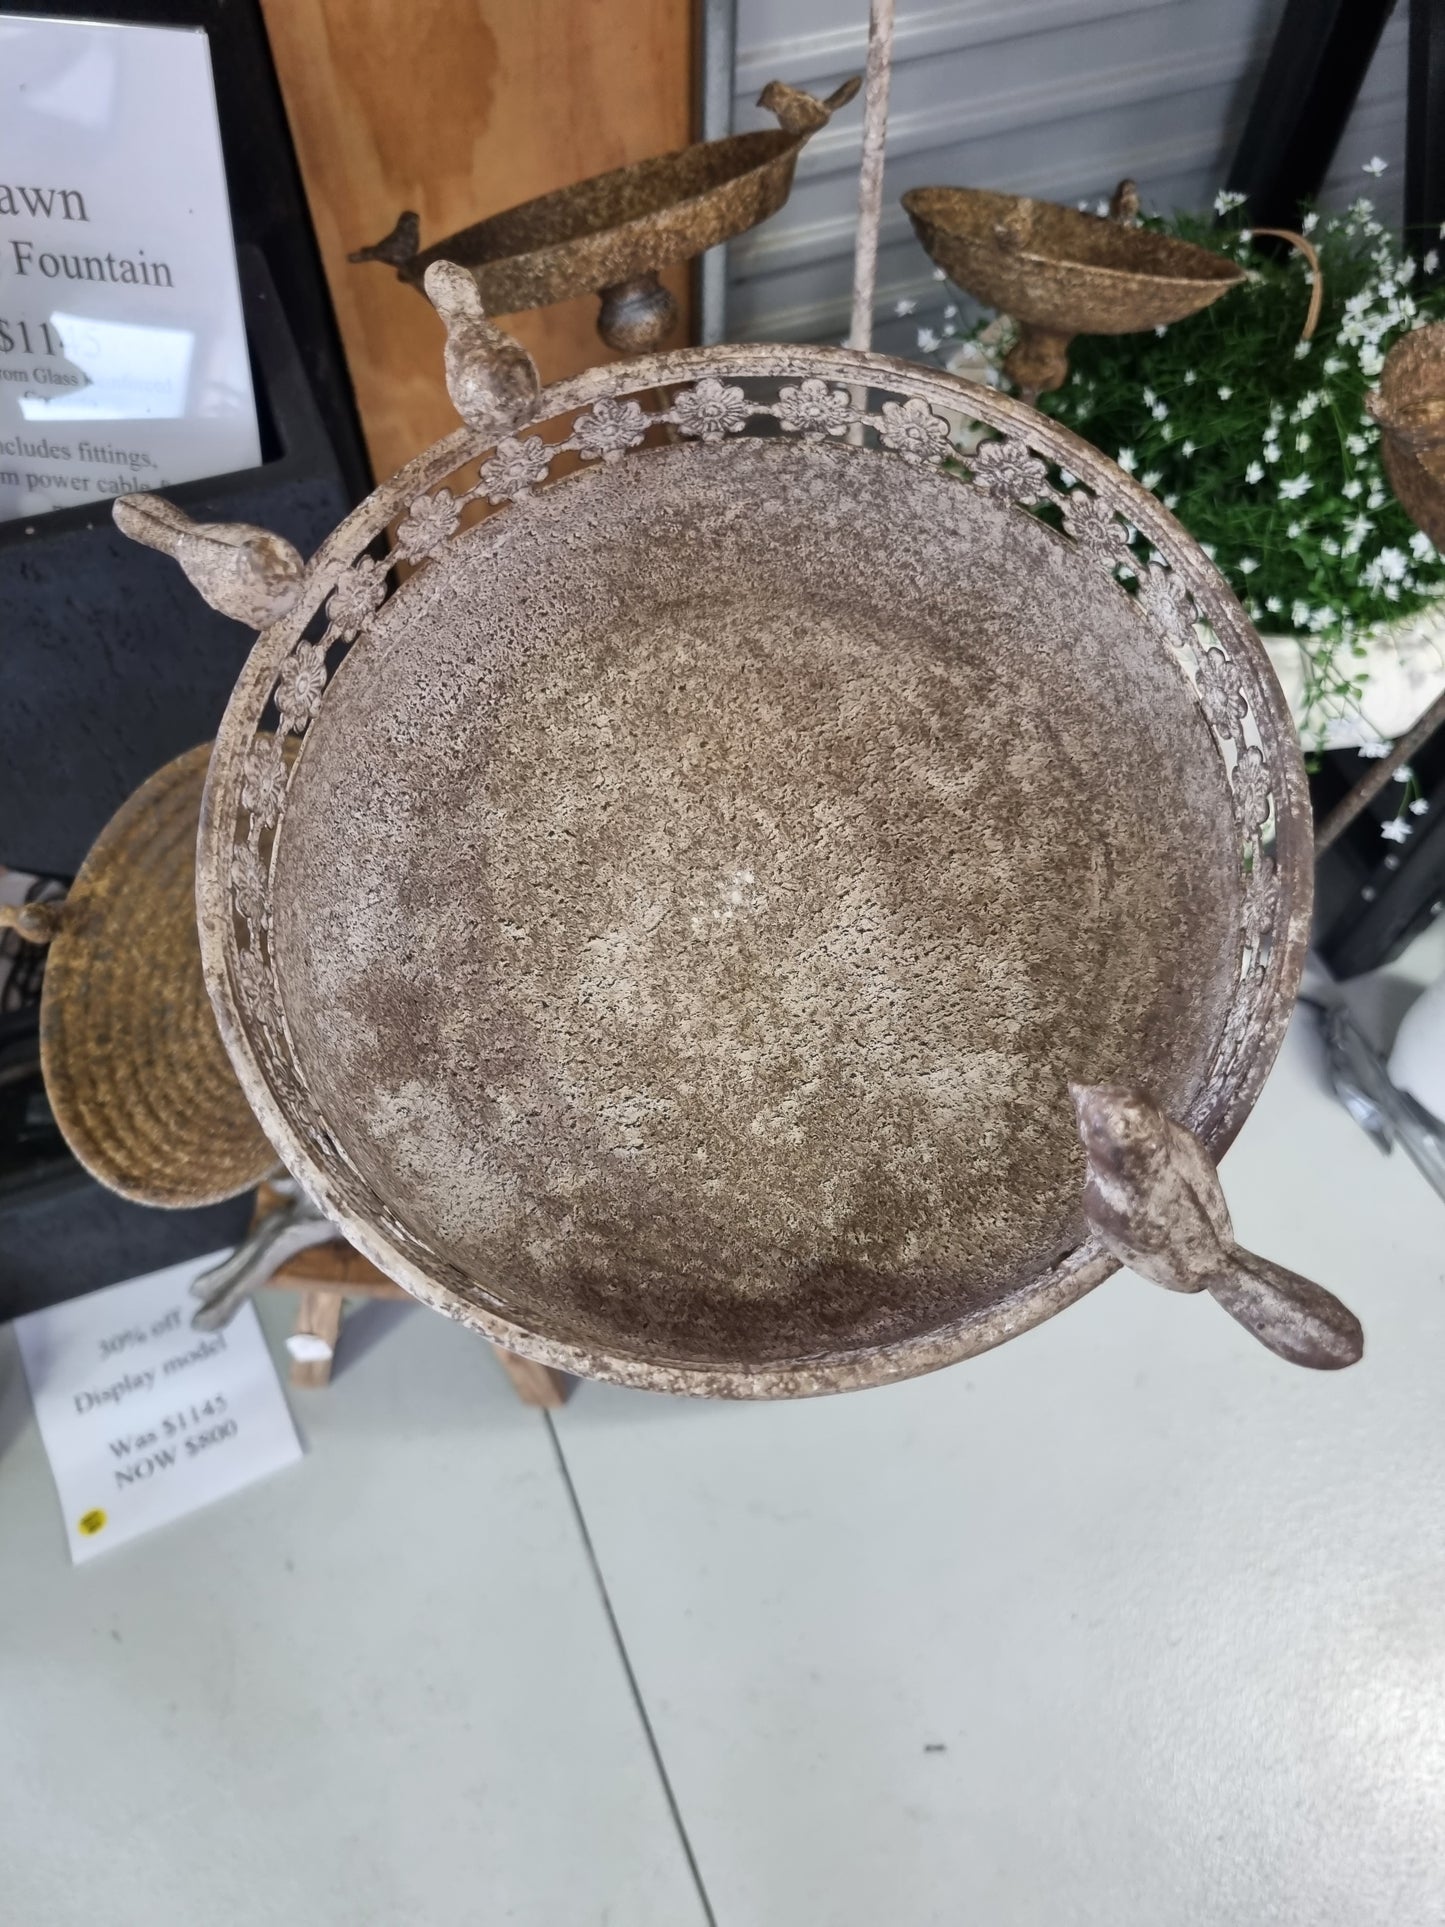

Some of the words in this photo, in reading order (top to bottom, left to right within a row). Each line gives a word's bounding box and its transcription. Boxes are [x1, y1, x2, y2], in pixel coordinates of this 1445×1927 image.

[0, 184, 90, 222] awn
[8, 239, 175, 288] Fountain
[0, 368, 29, 383] om
[32, 368, 80, 387] Glass
[79, 441, 158, 472] fittings,
[26, 472, 90, 493] power
[150, 1305, 181, 1338] off
[73, 1367, 156, 1415] Display
[162, 1331, 228, 1377] model
[107, 1433, 158, 1460] Was
[161, 1392, 228, 1439] $1145
[113, 1444, 177, 1490] NOW
